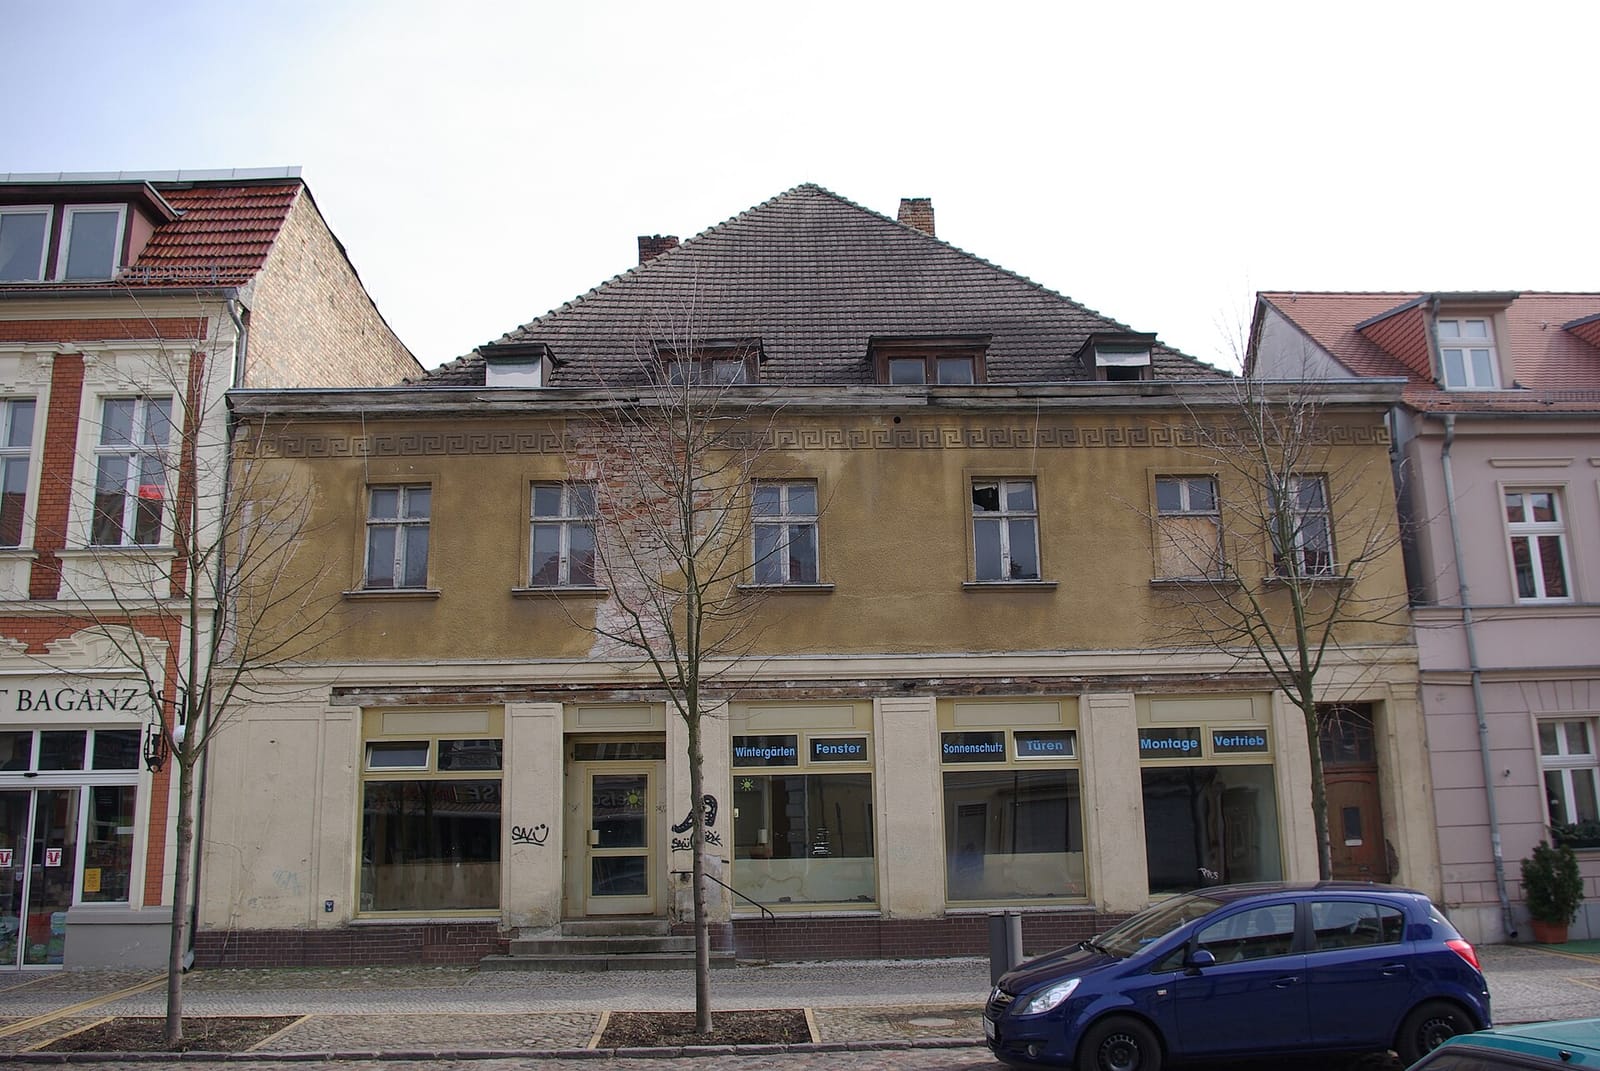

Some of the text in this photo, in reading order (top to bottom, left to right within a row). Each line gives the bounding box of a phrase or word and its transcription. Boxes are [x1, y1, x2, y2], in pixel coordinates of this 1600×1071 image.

[15, 688, 139, 712] BAGANZ
[1026, 740, 1064, 751] Türen
[1140, 737, 1199, 751] Montage
[1214, 735, 1265, 746] Vertrieb
[735, 745, 796, 760] Wintergärten
[815, 743, 861, 754] Fenster
[943, 742, 1004, 754] Sonnenschutz
